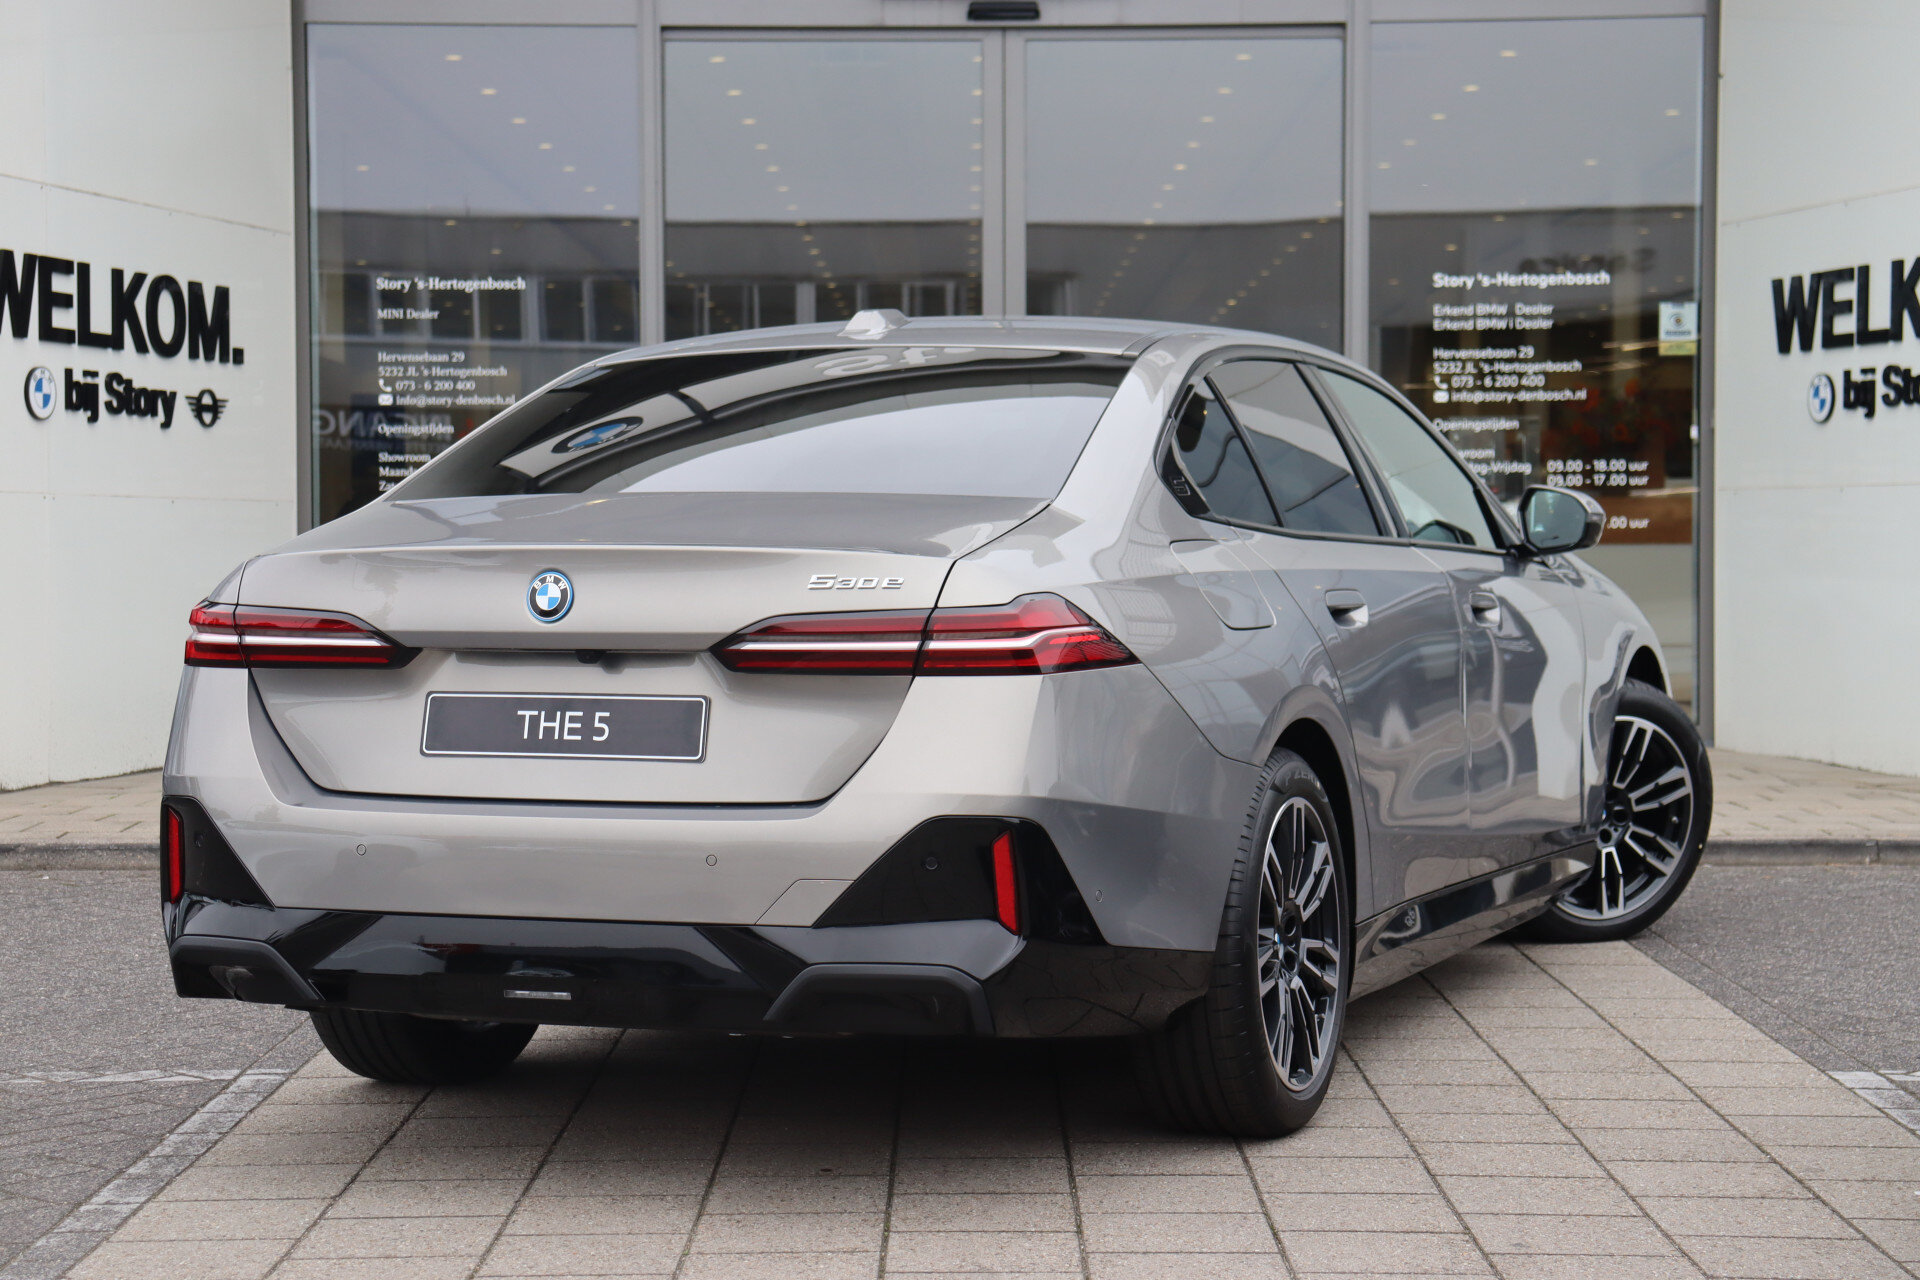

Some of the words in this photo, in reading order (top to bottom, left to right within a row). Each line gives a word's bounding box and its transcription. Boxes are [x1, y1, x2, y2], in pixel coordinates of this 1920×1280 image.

[376, 277, 411, 293] Story
[414, 276, 526, 293] 's-Hertogenbosch
[1432, 272, 1475, 290] Story
[1476, 271, 1610, 289] 's-Hertogenbosch
[377, 308, 403, 319] MINI
[406, 308, 440, 319] Dealer
[1433, 304, 1474, 317] Erkend
[1475, 303, 1508, 316] BMW
[1515, 302, 1554, 316] Dealer
[1433, 318, 1474, 331] Erkend
[1475, 317, 1508, 330] BMW
[1515, 317, 1554, 330] Dealer
[378, 352, 449, 363] Hervensebaan
[450, 351, 465, 363] 29
[1433, 347, 1517, 360] Hervensebaan
[1518, 345, 1534, 359] 29
[378, 366, 404, 377] 5232
[1433, 361, 1462, 375] 5232
[395, 380, 416, 391] 073
[424, 380, 432, 391] 6
[433, 380, 454, 391] 200
[455, 380, 476, 391] 400
[1451, 375, 1474, 388] 073
[1483, 375, 1493, 388] 6
[1494, 374, 1519, 388] 200
[1520, 373, 1545, 387] 400
[104, 372, 177, 430] Story
[1450, 388, 1588, 404] info@story-denbosch.nl
[377, 424, 455, 436] Openingstijden
[1433, 418, 1520, 433] Openingstijden
[378, 451, 432, 463] Showroom
[379, 465, 418, 477] Maand
[1546, 459, 1583, 473] 09.00
[1628, 461, 1649, 472] uur
[1628, 475, 1650, 487] uur
[1628, 518, 1650, 529] uur
[807, 574, 905, 590] 530e
[517, 710, 583, 740] THE
[592, 711, 611, 741] 5
